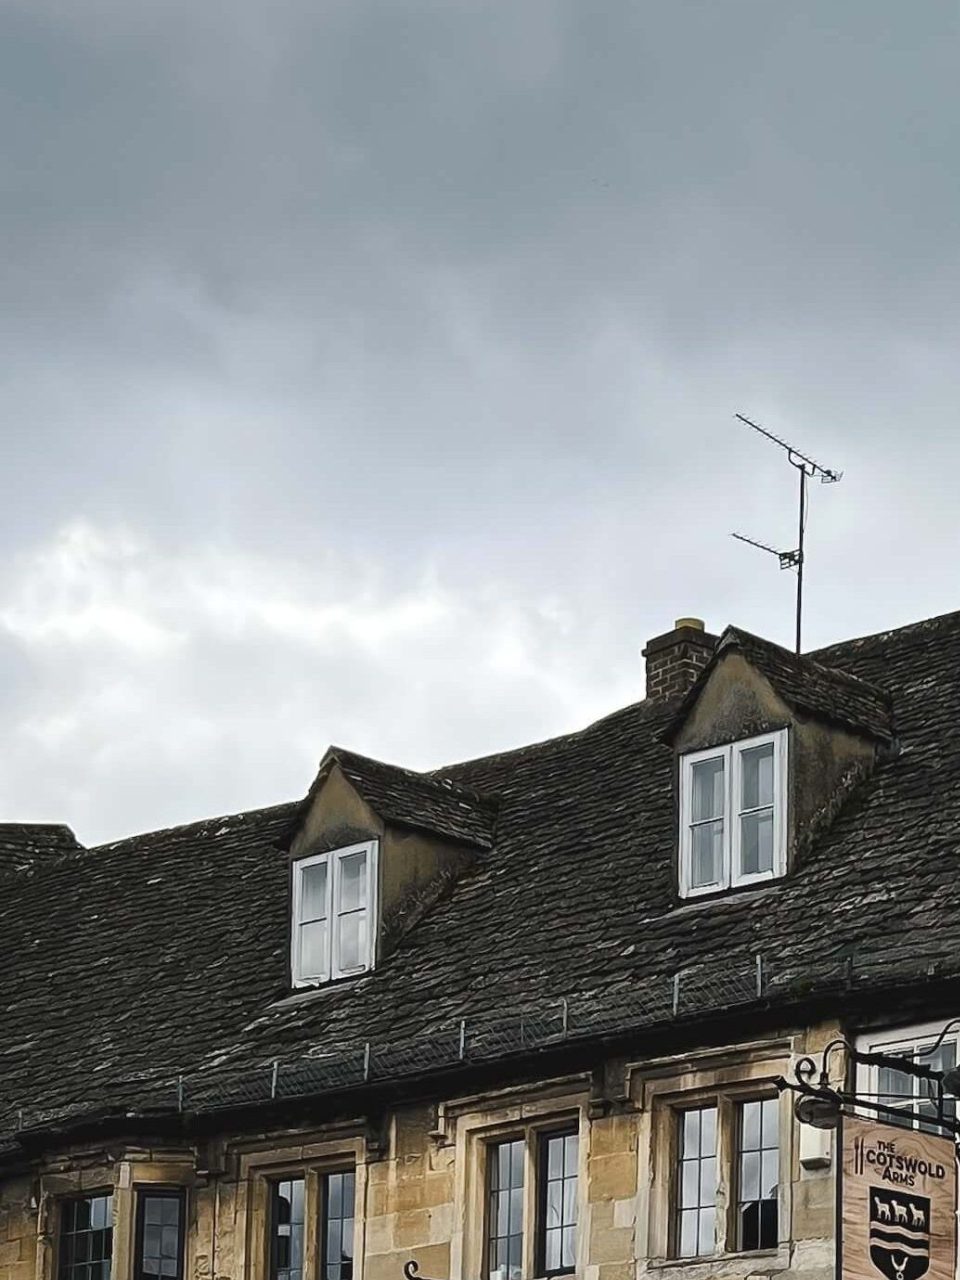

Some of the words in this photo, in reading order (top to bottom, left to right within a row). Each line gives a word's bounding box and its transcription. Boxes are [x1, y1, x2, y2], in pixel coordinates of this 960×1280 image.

[877, 1140, 895, 1154] THE
[866, 1149, 946, 1180] COTSWOLD
[882, 1166, 915, 1187] ARMS
